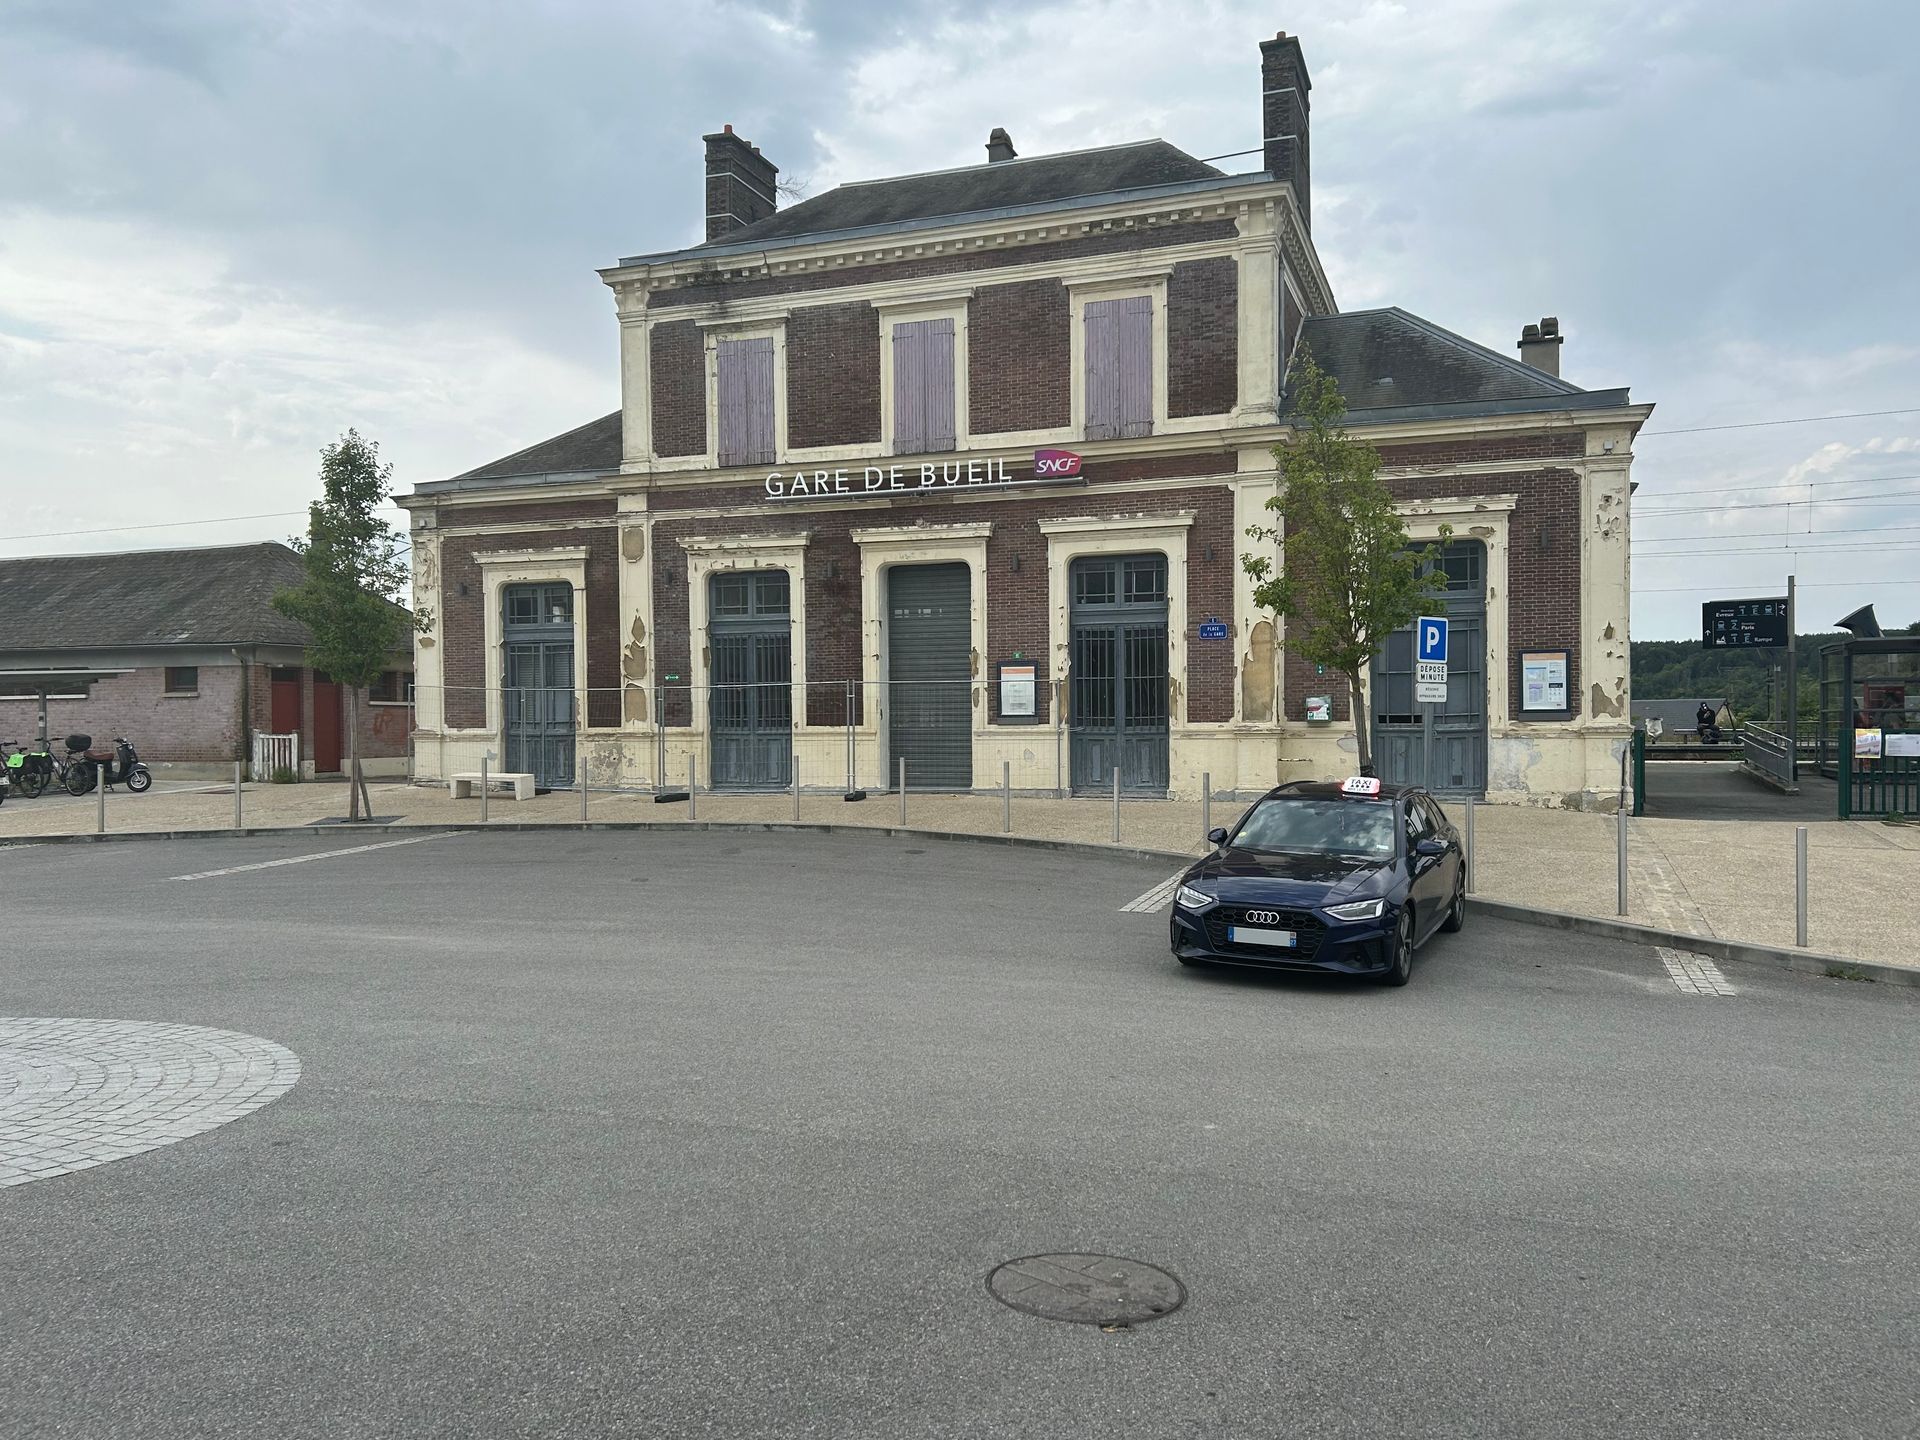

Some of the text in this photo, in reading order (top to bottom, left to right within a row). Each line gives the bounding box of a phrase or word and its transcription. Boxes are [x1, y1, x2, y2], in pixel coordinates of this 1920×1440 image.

[1036, 457, 1079, 473] SNCF
[765, 458, 1012, 496] GARE DE BUEIL
[1426, 626, 1440, 653] P
[1420, 665, 1445, 673] DÉPOSE
